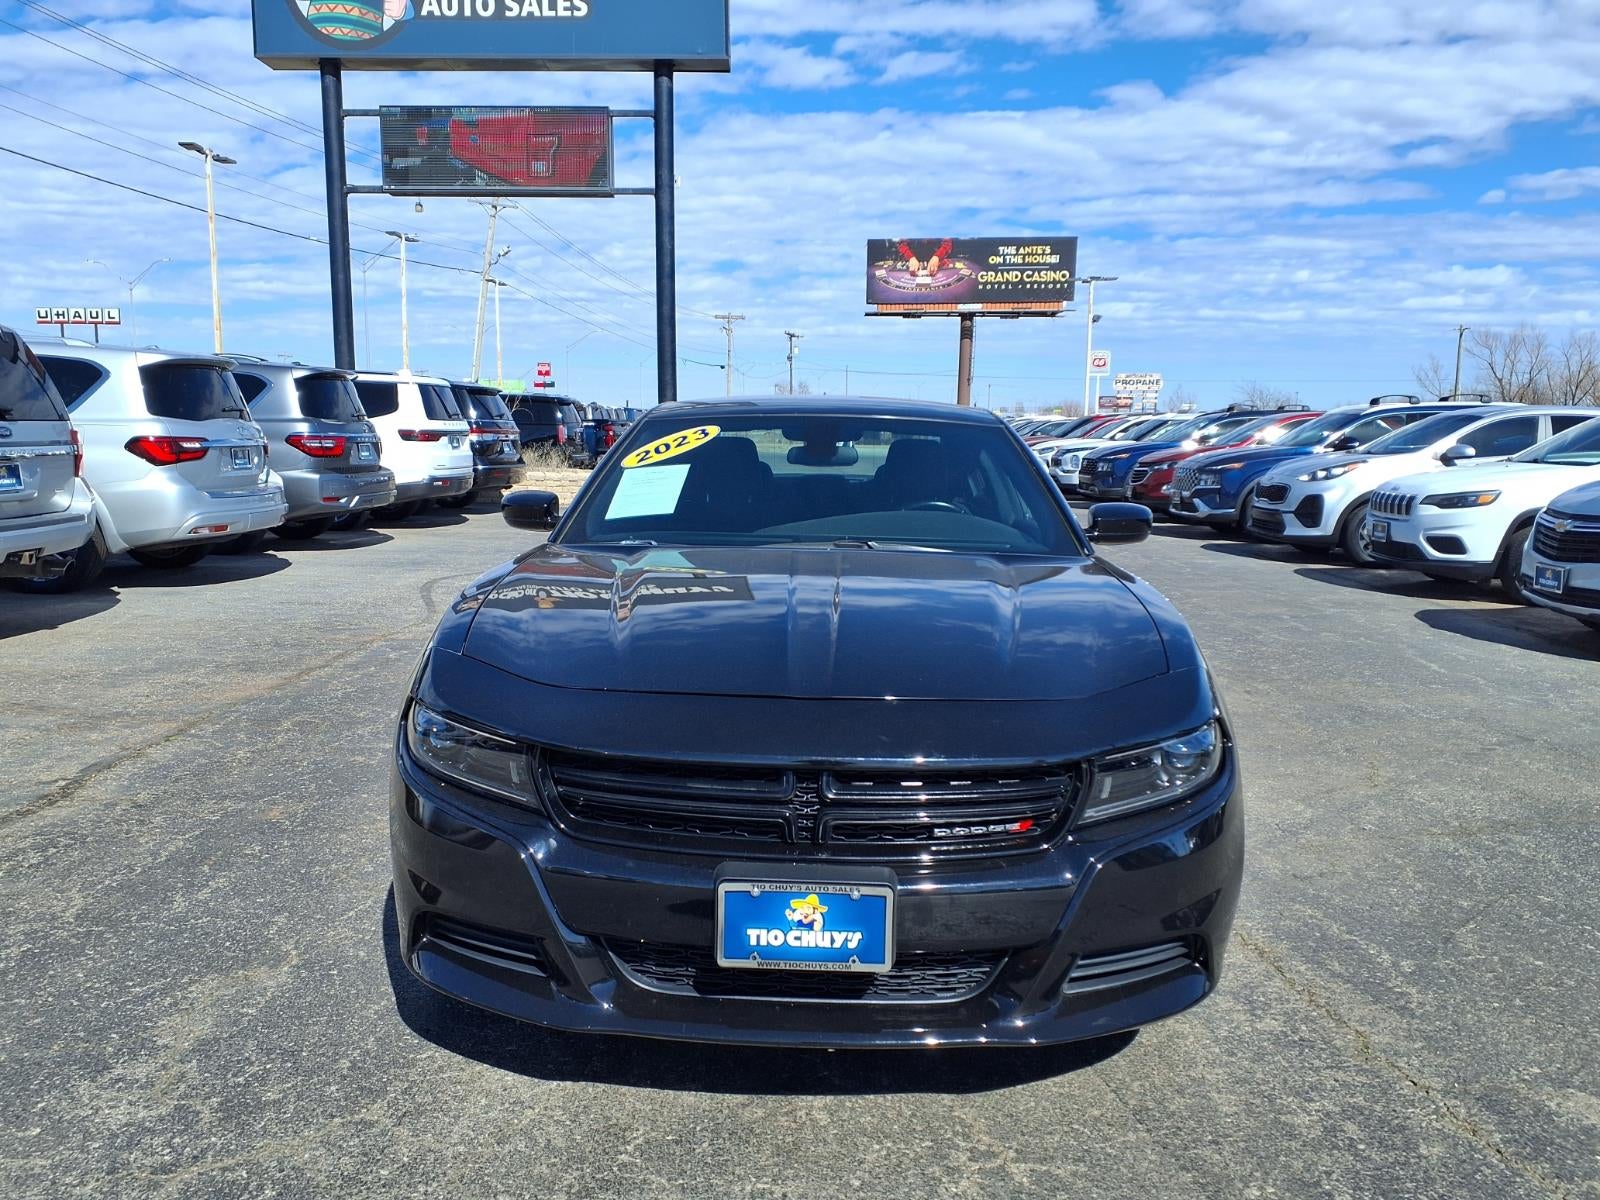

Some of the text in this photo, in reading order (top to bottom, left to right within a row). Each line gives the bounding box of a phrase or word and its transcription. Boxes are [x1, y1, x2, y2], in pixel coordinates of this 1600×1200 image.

[420, 0, 589, 17] AUTO SALES
[998, 245, 1051, 255] THE ANTE'S
[988, 254, 1060, 264] ON THE HOUSE!
[977, 270, 1070, 282] GRAND CASINO
[1114, 378, 1161, 386] PROPANE
[635, 428, 709, 464] 2023
[805, 885, 830, 893] AUTO
[756, 960, 852, 970] WWW.TIOCHUYS.COM
